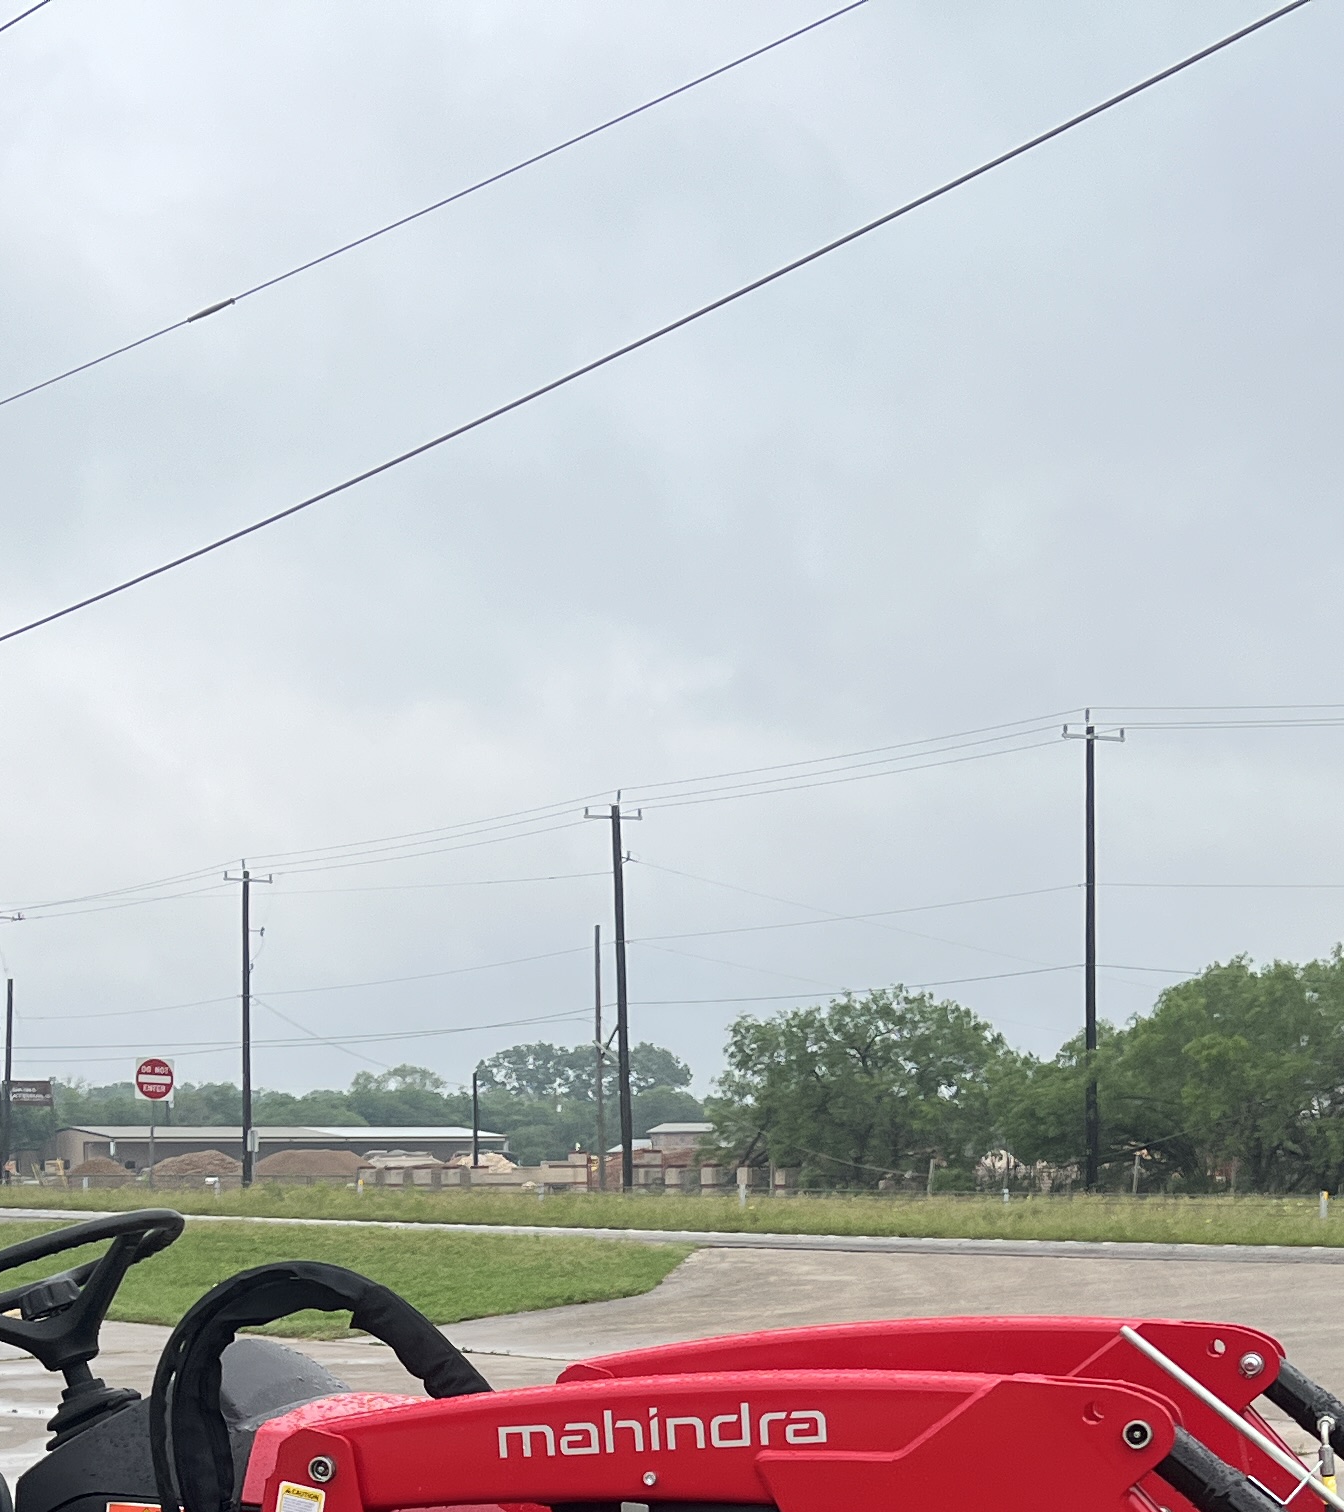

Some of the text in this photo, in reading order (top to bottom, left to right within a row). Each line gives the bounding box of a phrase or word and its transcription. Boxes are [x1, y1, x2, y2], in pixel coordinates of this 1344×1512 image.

[141, 1065, 169, 1074] DO NOT
[143, 1084, 166, 1092] ENTER
[497, 1402, 828, 1459] mahindra
[291, 1488, 319, 1501] CAUTION
